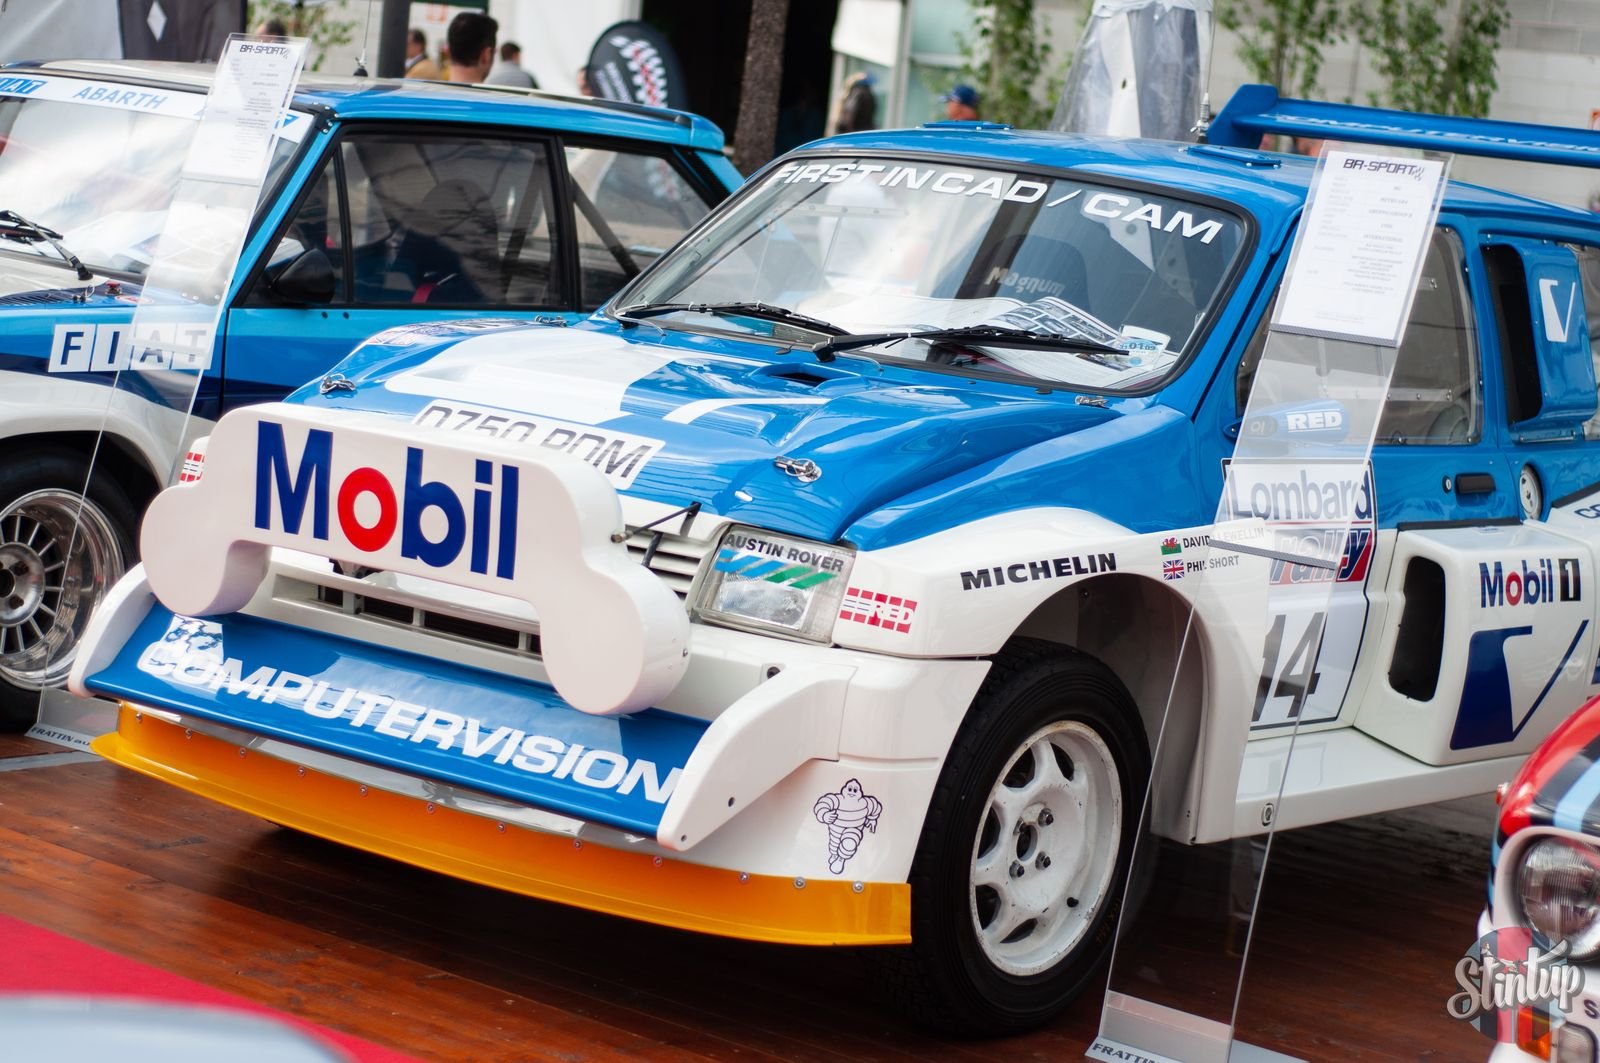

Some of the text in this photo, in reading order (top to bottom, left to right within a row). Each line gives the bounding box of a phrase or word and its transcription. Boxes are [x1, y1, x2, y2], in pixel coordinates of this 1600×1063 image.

[72, 86, 168, 109] ABARTH
[1343, 158, 1417, 176] BR-SPORT
[763, 164, 885, 188] FIRST
[879, 166, 936, 190] IN
[932, 172, 1048, 204] CAD
[1084, 193, 1224, 244] CAM
[984, 267, 1065, 297] Magnum
[60, 330, 207, 366] FIAT
[1286, 410, 1342, 432] RED
[254, 420, 519, 581] Mobil
[1229, 469, 1373, 521] Lombard
[723, 534, 845, 572] AUSTIN ROVER
[960, 553, 1117, 591] MICHELIN
[1209, 555, 1240, 569] SHORT
[1270, 529, 1370, 585] rally
[1479, 558, 1578, 608] Mobil 1
[1251, 612, 1328, 722] 14
[31, 727, 73, 742] FRATTIN
[137, 641, 684, 804] COMPUTERVISION
